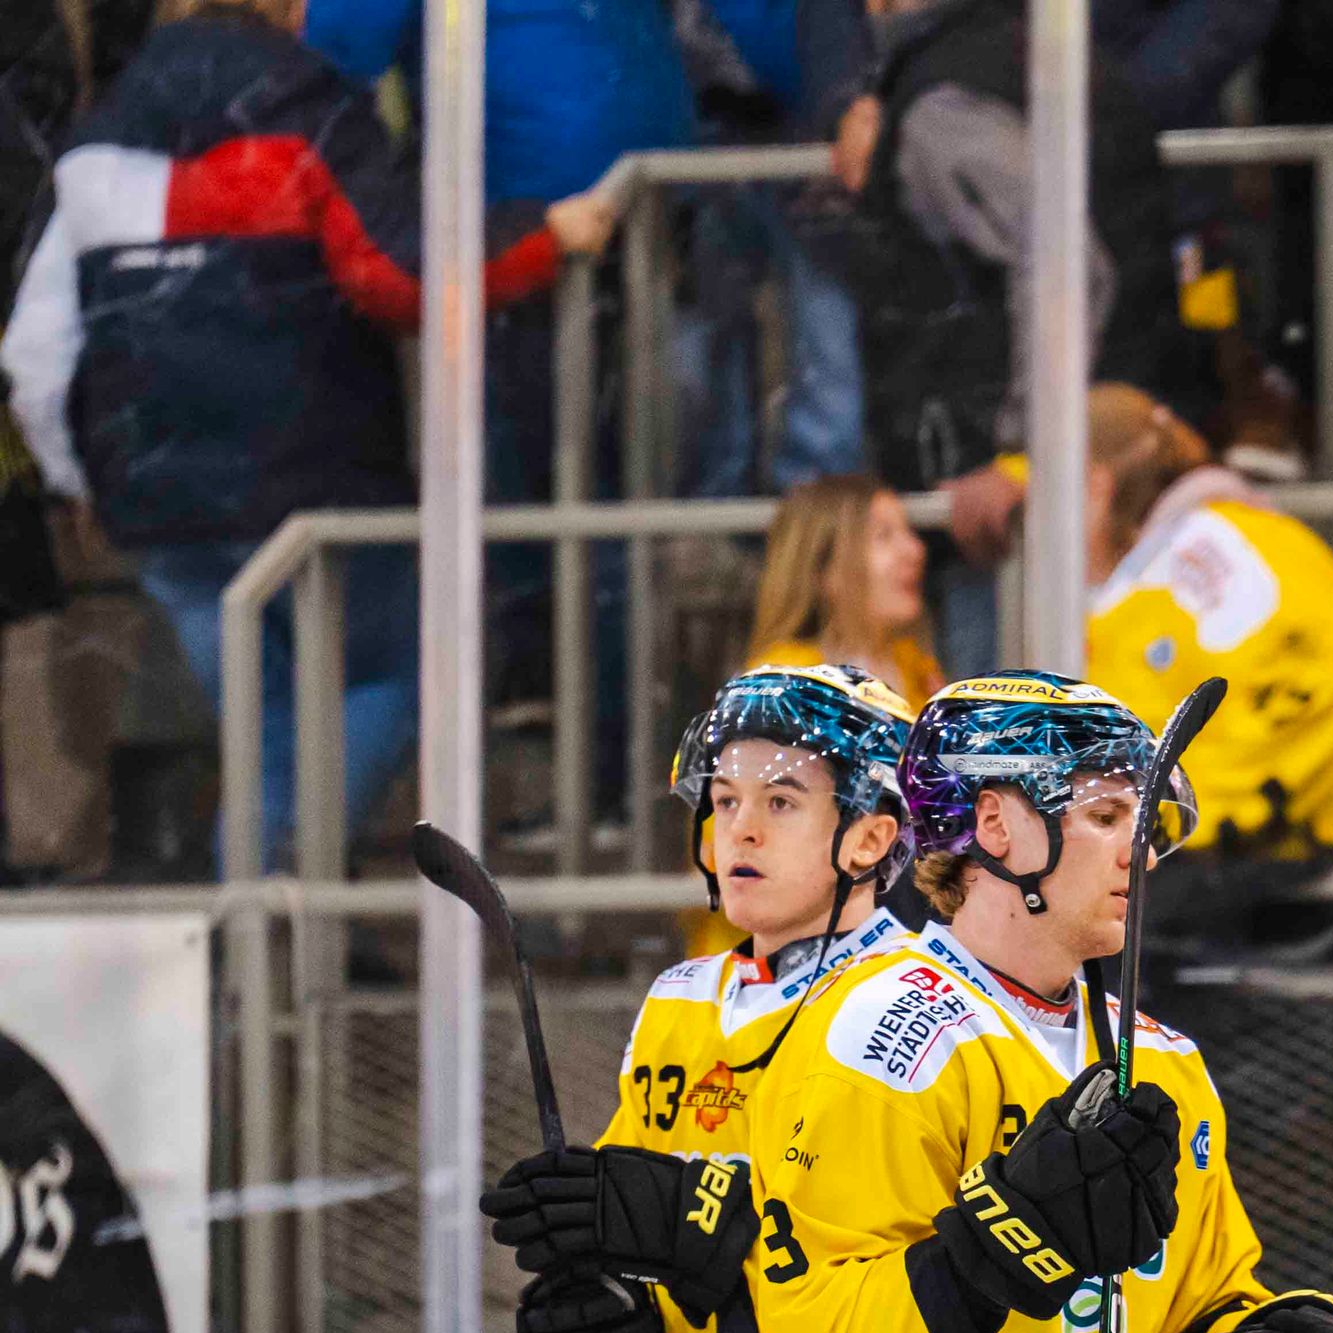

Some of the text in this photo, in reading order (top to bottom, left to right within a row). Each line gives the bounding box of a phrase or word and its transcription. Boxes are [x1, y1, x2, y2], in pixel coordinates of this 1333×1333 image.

[952, 680, 1064, 701] ADMIRAL
[863, 989, 927, 1064] WIENER
[633, 1064, 686, 1132] 33
